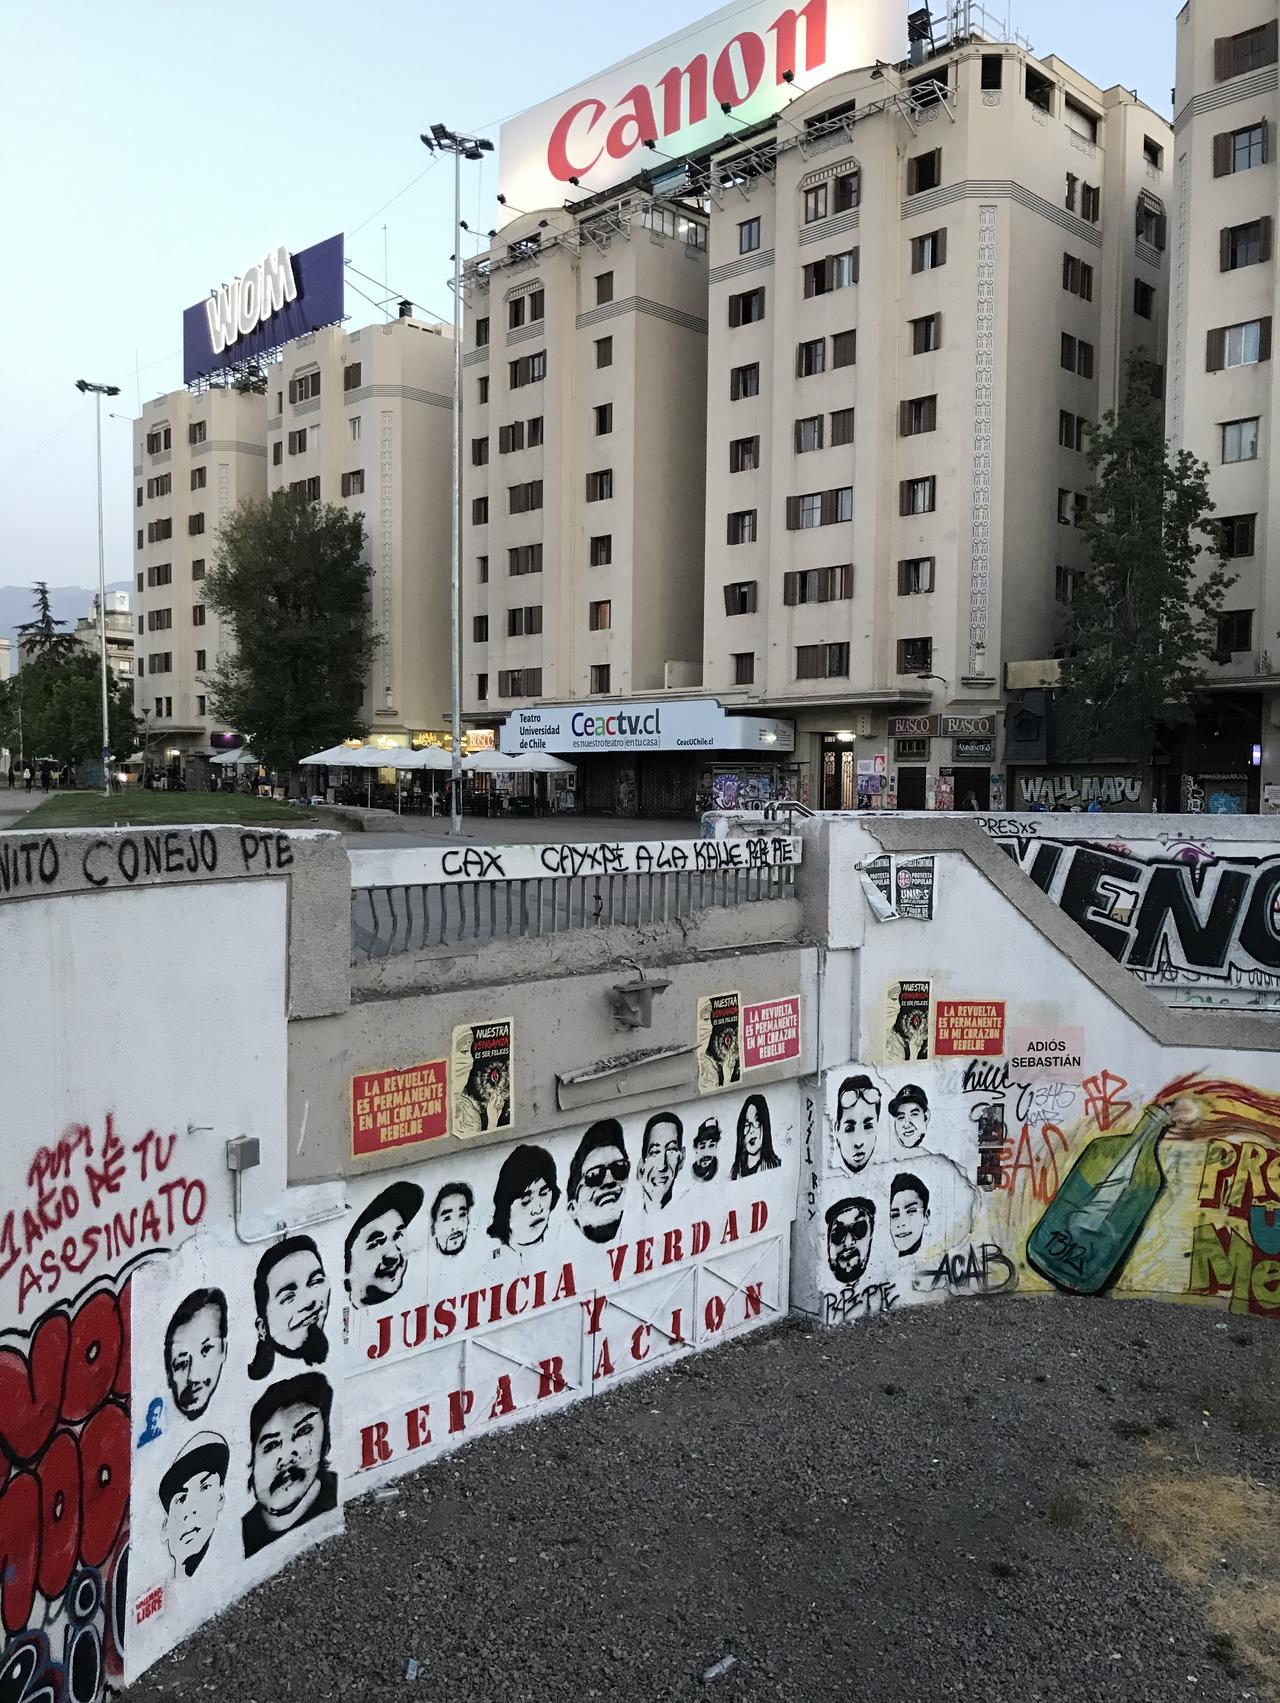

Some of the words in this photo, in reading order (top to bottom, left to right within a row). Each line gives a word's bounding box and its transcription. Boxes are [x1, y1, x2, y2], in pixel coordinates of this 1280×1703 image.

[547, 0, 827, 182] Canon
[206, 245, 298, 355] WOM
[520, 713, 541, 723] Teatro
[571, 708, 662, 737] Ceactv.cl
[520, 725, 560, 736] Universidad
[520, 740, 528, 749] de
[529, 739, 546, 749] Chile
[1020, 776, 1079, 806] WALL
[1082, 776, 1143, 805] MAPU
[82, 829, 219, 886] CONEJO
[240, 833, 295, 871] PTE
[442, 850, 506, 878] CAX
[636, 845, 654, 874] A
[903, 983, 928, 992] NUESTRA
[713, 996, 737, 1009] NUESTRA
[750, 1011, 759, 1023] LA
[761, 1003, 793, 1021] REVUELTA
[944, 1005, 955, 1017] LA
[958, 1005, 997, 1017] REVUELTA
[476, 1025, 509, 1039] NUESTRA
[745, 1025, 753, 1037] ES
[755, 1015, 798, 1035] PERMANENTE
[938, 1017, 948, 1028] ES
[950, 1017, 1002, 1028] PERMANENTE
[939, 1028, 949, 1040] EN
[951, 1028, 962, 1039] MI
[963, 1028, 1000, 1039] CORAZON
[746, 1037, 756, 1049] EN
[757, 1035, 766, 1047] MI
[767, 1028, 797, 1045] CORAZON
[953, 1039, 985, 1051] REBELDE
[1027, 1038, 1066, 1052] ADIÓS
[482, 1050, 491, 1058] SER
[491, 1048, 509, 1056] FELICES
[759, 1042, 785, 1059] REBELDE
[1011, 1054, 1081, 1069] SEBASTIÁN
[364, 1080, 380, 1097] LA
[384, 1069, 436, 1093] REVUELTA
[357, 1098, 370, 1116] ES
[374, 1083, 443, 1111] PERMANENTE
[359, 1113, 373, 1131] EN
[377, 1110, 390, 1127] MI
[394, 1099, 442, 1124] CORAZON
[380, 1119, 423, 1143] REBELDE
[133, 1130, 178, 1181] TU
[367, 1262, 578, 1360] JUSTICIA
[606, 1199, 769, 1282] VERDAD
[921, 1243, 1020, 1294] ACAB
[581, 1296, 607, 1335] Y
[360, 1281, 764, 1470] REPARACION
[137, 1599, 162, 1624] LIBRE
